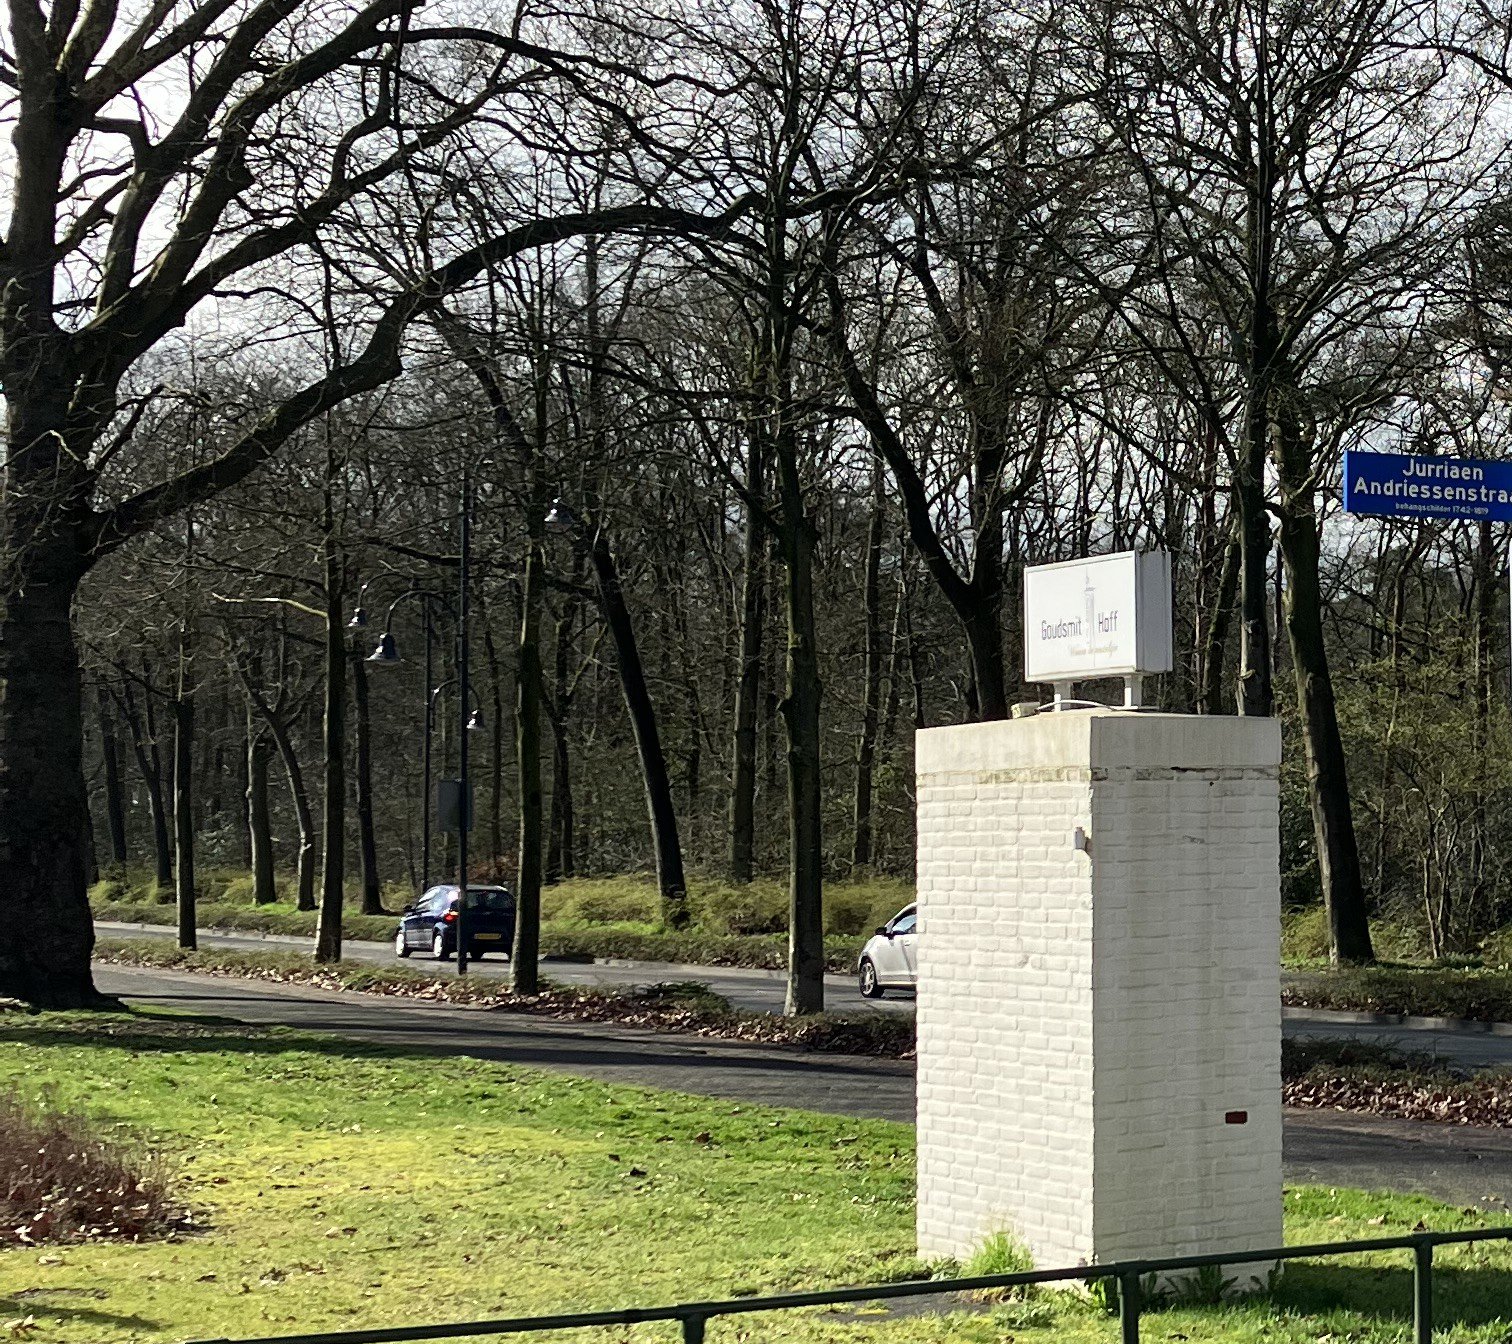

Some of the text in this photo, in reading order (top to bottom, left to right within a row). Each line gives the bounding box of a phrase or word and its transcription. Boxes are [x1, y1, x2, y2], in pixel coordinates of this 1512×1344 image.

[1402, 459, 1483, 481] Jurriaen
[1041, 609, 1119, 641] Goudsmit Hoff
